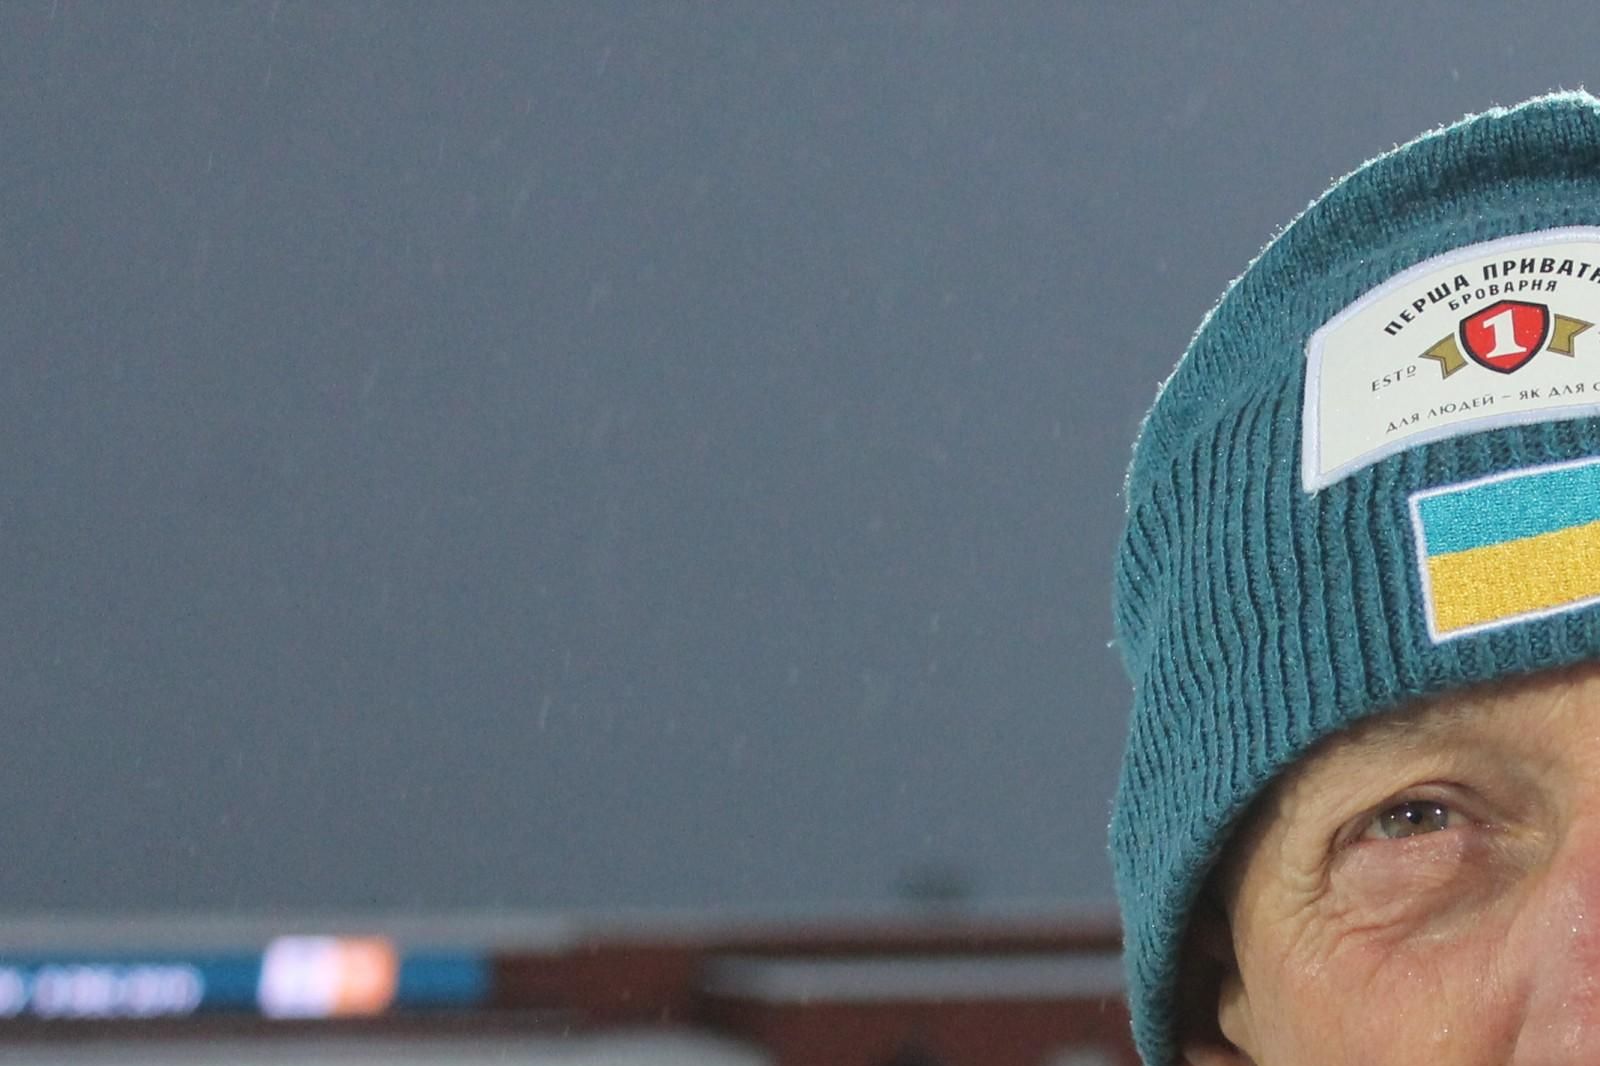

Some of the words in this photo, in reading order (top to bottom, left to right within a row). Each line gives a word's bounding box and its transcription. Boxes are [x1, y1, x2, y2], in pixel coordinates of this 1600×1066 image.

[1385, 274, 1469, 336] ПЕРША
[1448, 280, 1558, 311] БРОВАРНЯ
[1483, 309, 1527, 359] 1
[1385, 412, 1420, 433] ДЛЯ
[1427, 394, 1494, 420] ЛЮДЕЙ
[1518, 387, 1541, 399] ЯК
[1548, 382, 1586, 397] ДЛЯ
